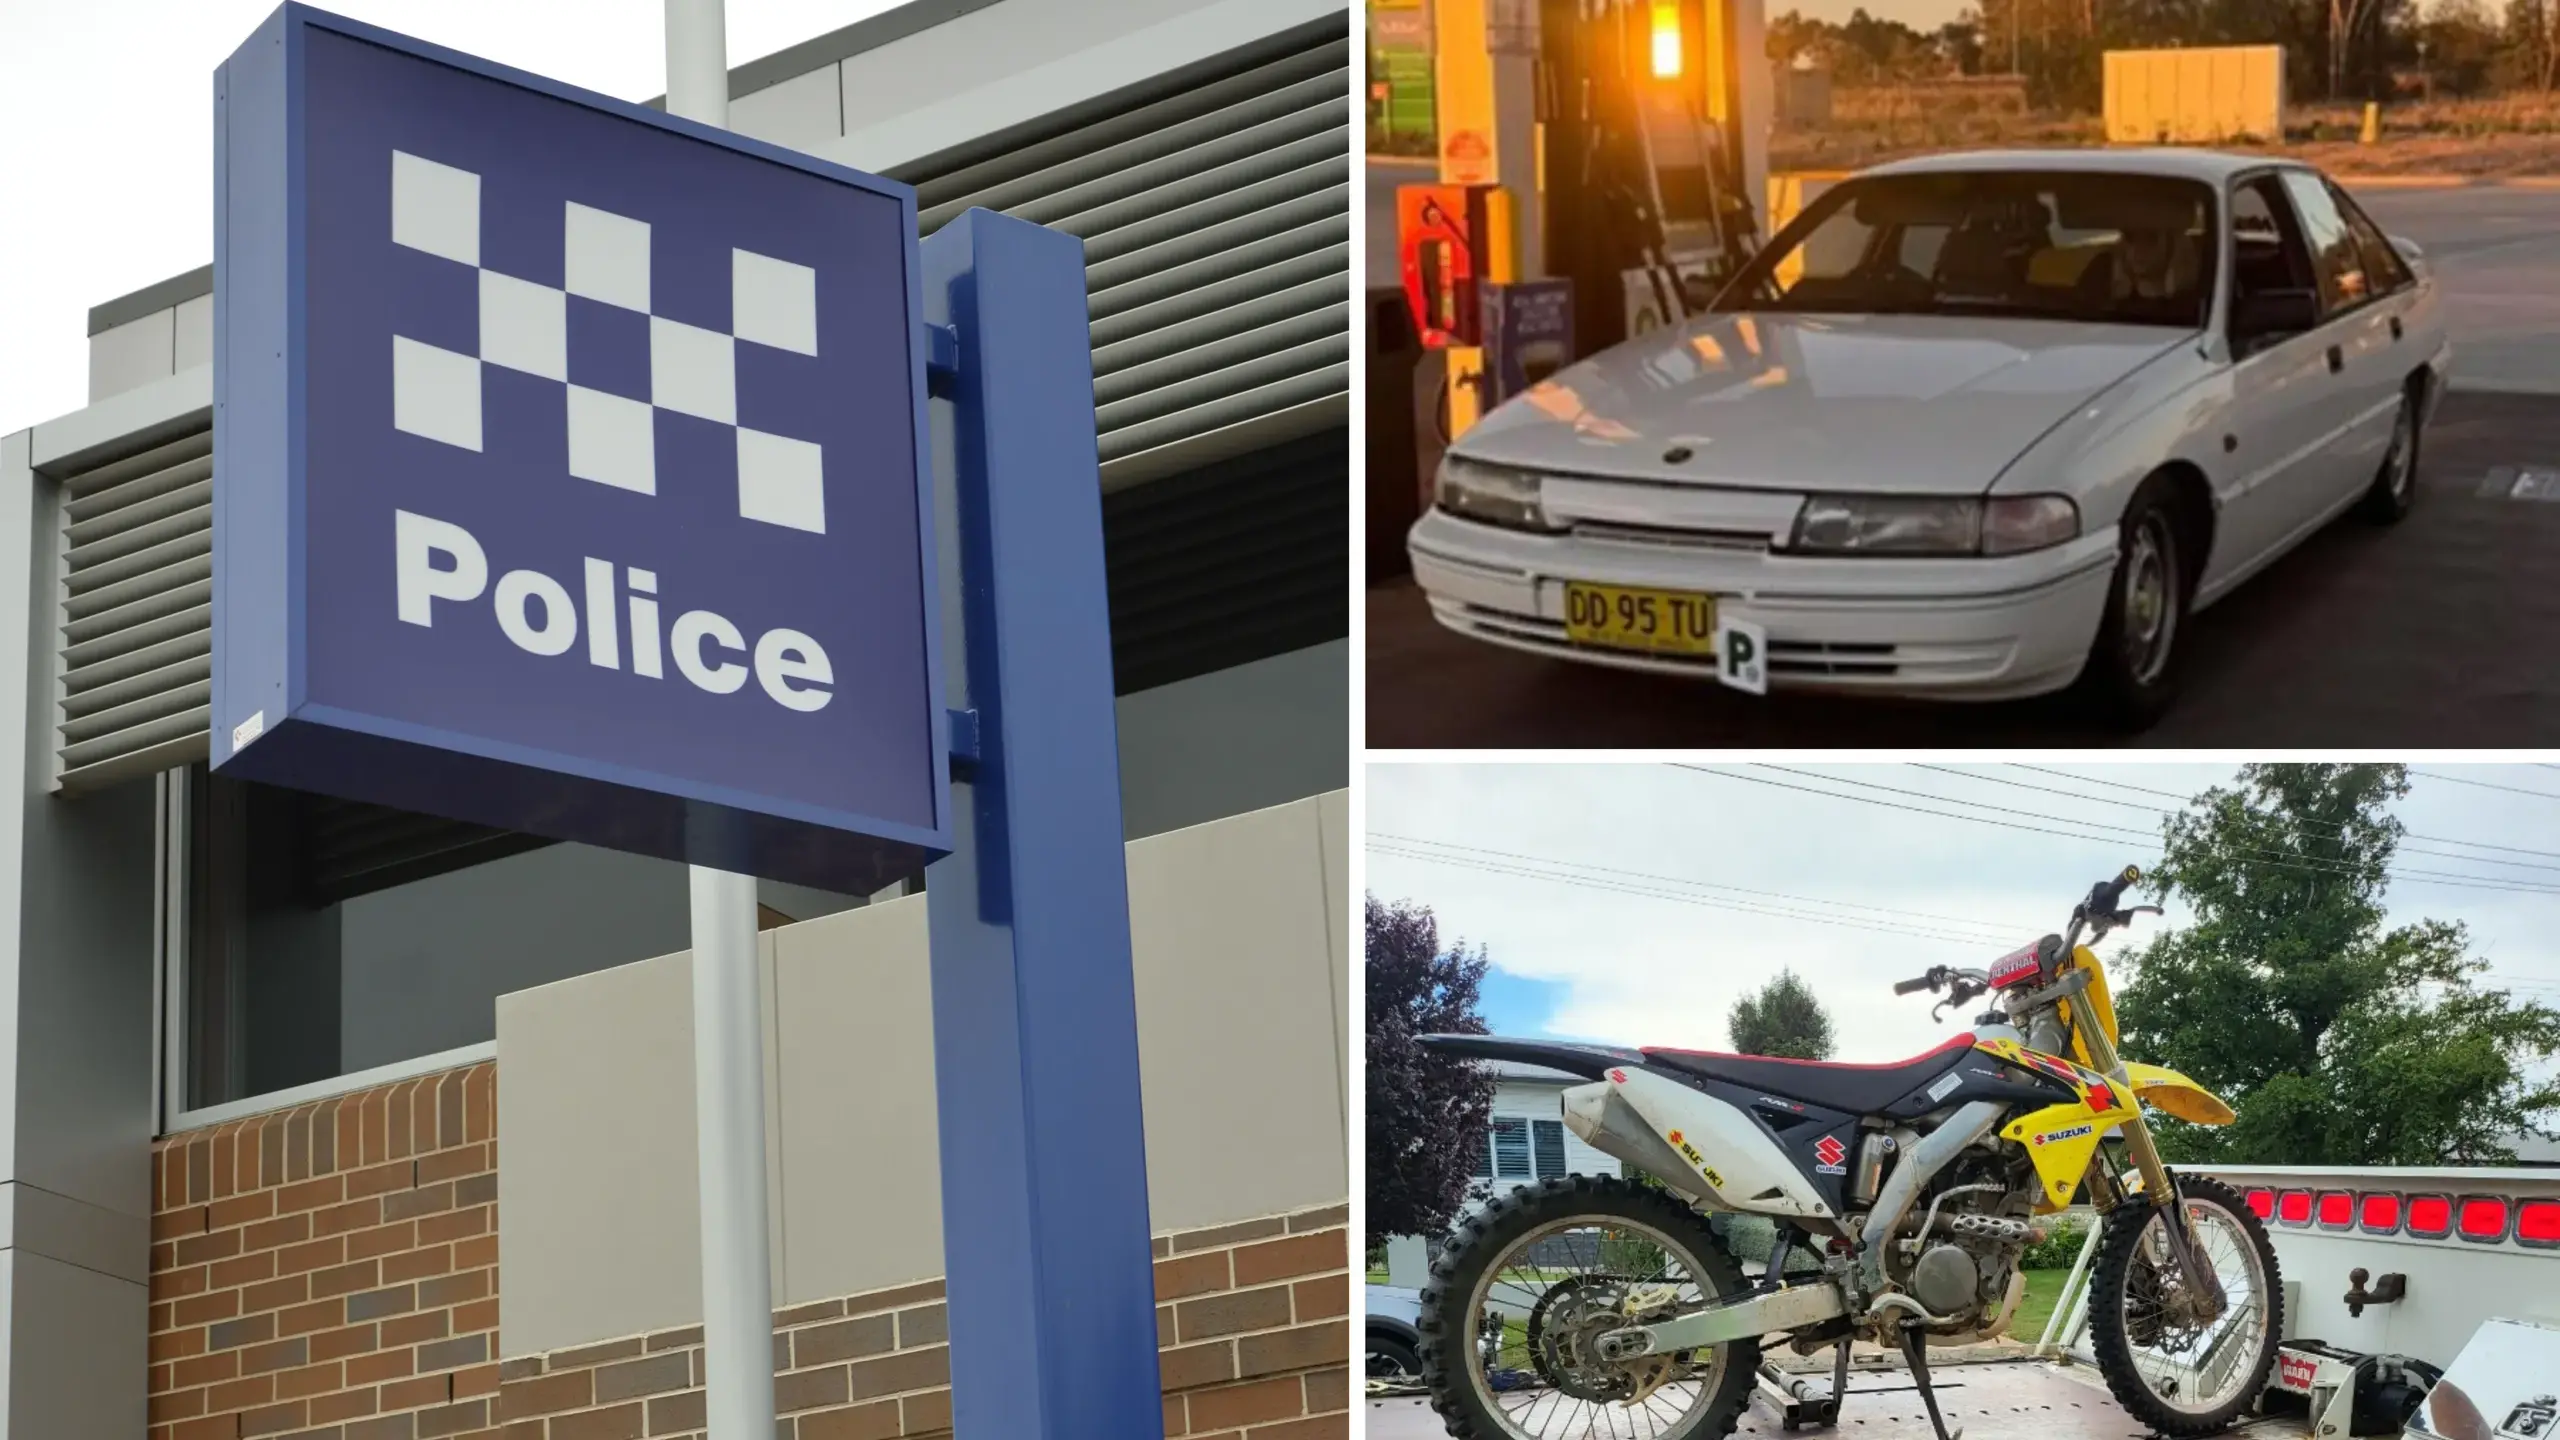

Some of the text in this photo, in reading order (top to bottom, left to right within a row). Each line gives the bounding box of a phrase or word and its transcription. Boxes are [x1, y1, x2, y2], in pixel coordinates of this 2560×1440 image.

[396, 508, 834, 712] Police
[1569, 589, 1709, 639] DD 95 TU
[1727, 629, 1755, 678] P
[2047, 1125, 2092, 1142] SUZUKI
[1681, 1143, 1724, 1187] SUUKI
